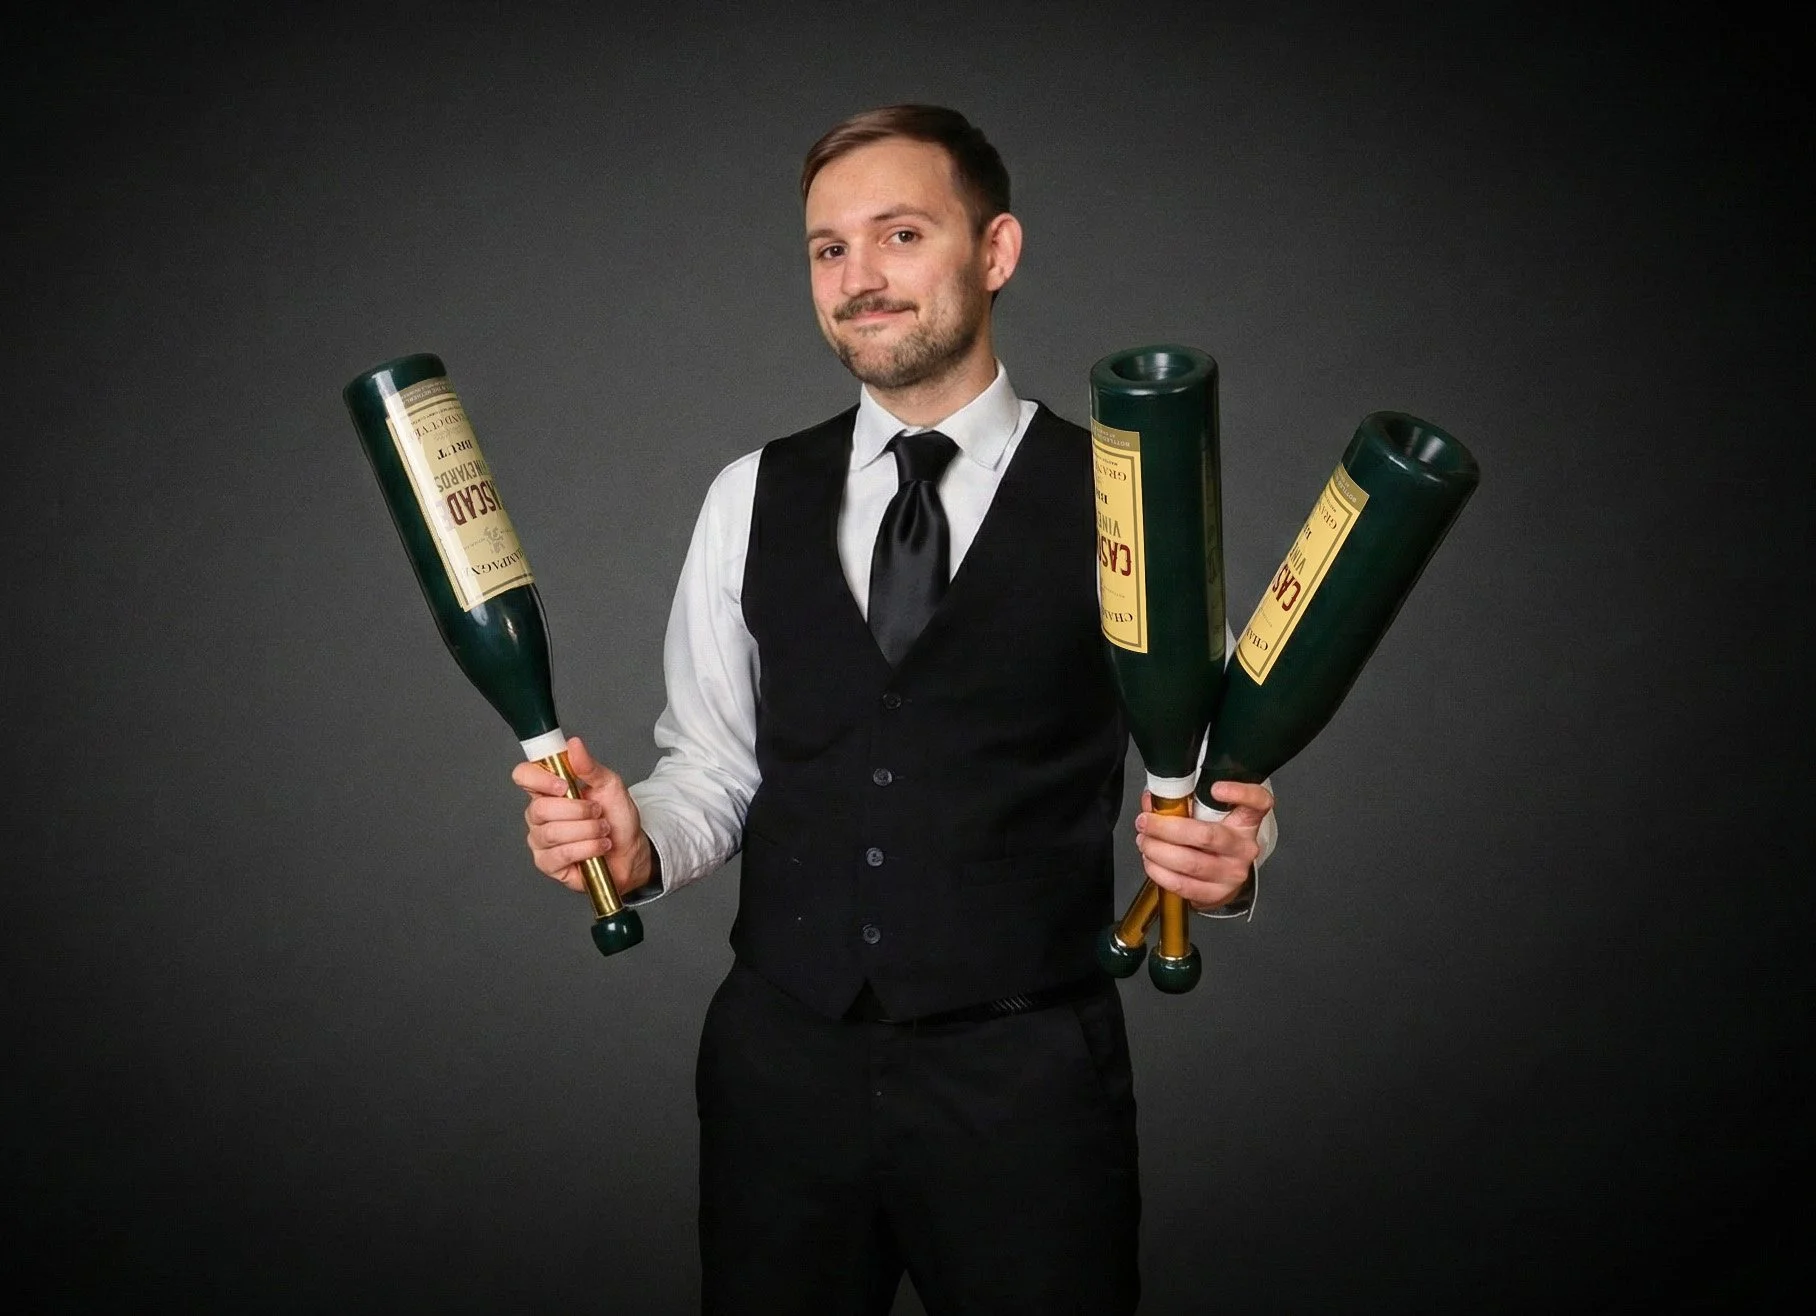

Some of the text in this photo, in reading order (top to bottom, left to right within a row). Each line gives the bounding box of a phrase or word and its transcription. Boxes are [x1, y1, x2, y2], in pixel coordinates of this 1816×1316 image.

[437, 439, 473, 460] BRUT
[434, 459, 488, 493] INEYARDS
[437, 480, 502, 532] ASCAD
[1099, 535, 1132, 577] CAS
